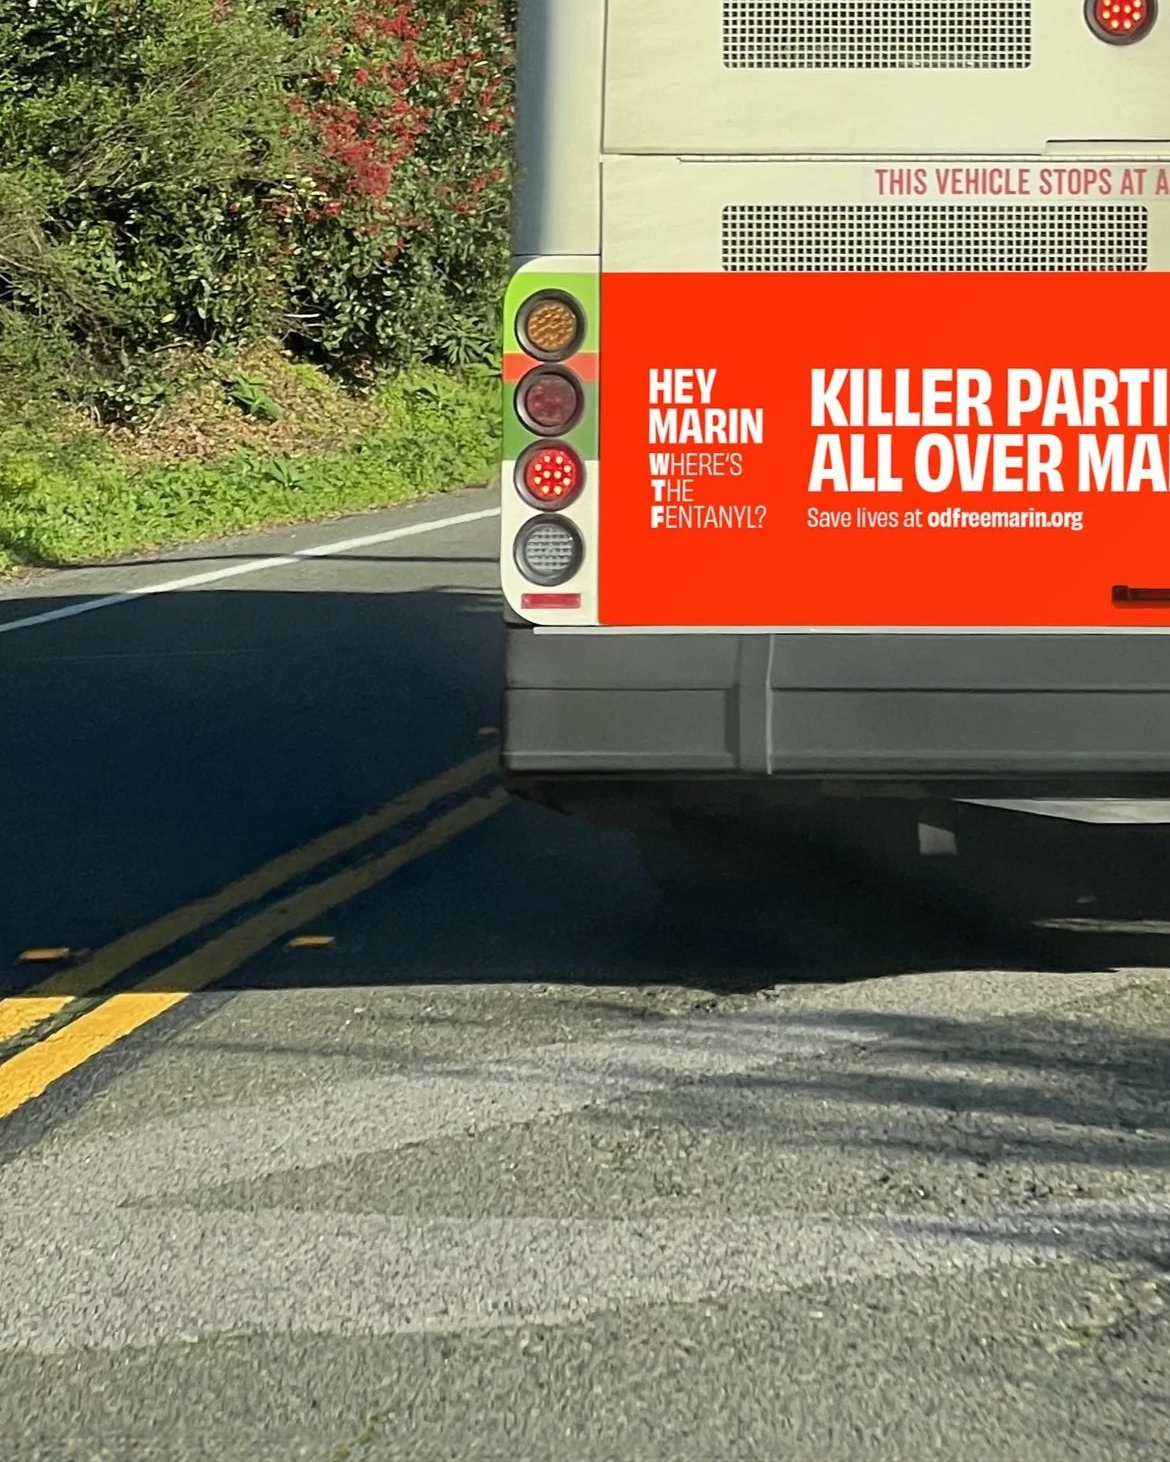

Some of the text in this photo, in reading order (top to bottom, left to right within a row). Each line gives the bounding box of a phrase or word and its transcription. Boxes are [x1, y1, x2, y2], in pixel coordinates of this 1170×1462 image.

[875, 168, 927, 196] THIS
[936, 168, 1030, 196] VEHICLE
[1039, 168, 1112, 196] STOPS
[1120, 168, 1147, 196] AT
[648, 368, 718, 404] HEY
[810, 368, 994, 427] KILLER
[648, 408, 764, 444] MARIN
[648, 453, 743, 476] WHERE'S
[807, 433, 903, 493] ALL
[914, 432, 1064, 493] OVER
[651, 479, 694, 502] THE
[651, 505, 767, 529] FENTANYL?
[807, 507, 1084, 532] Save lives at odfreemarin.org
